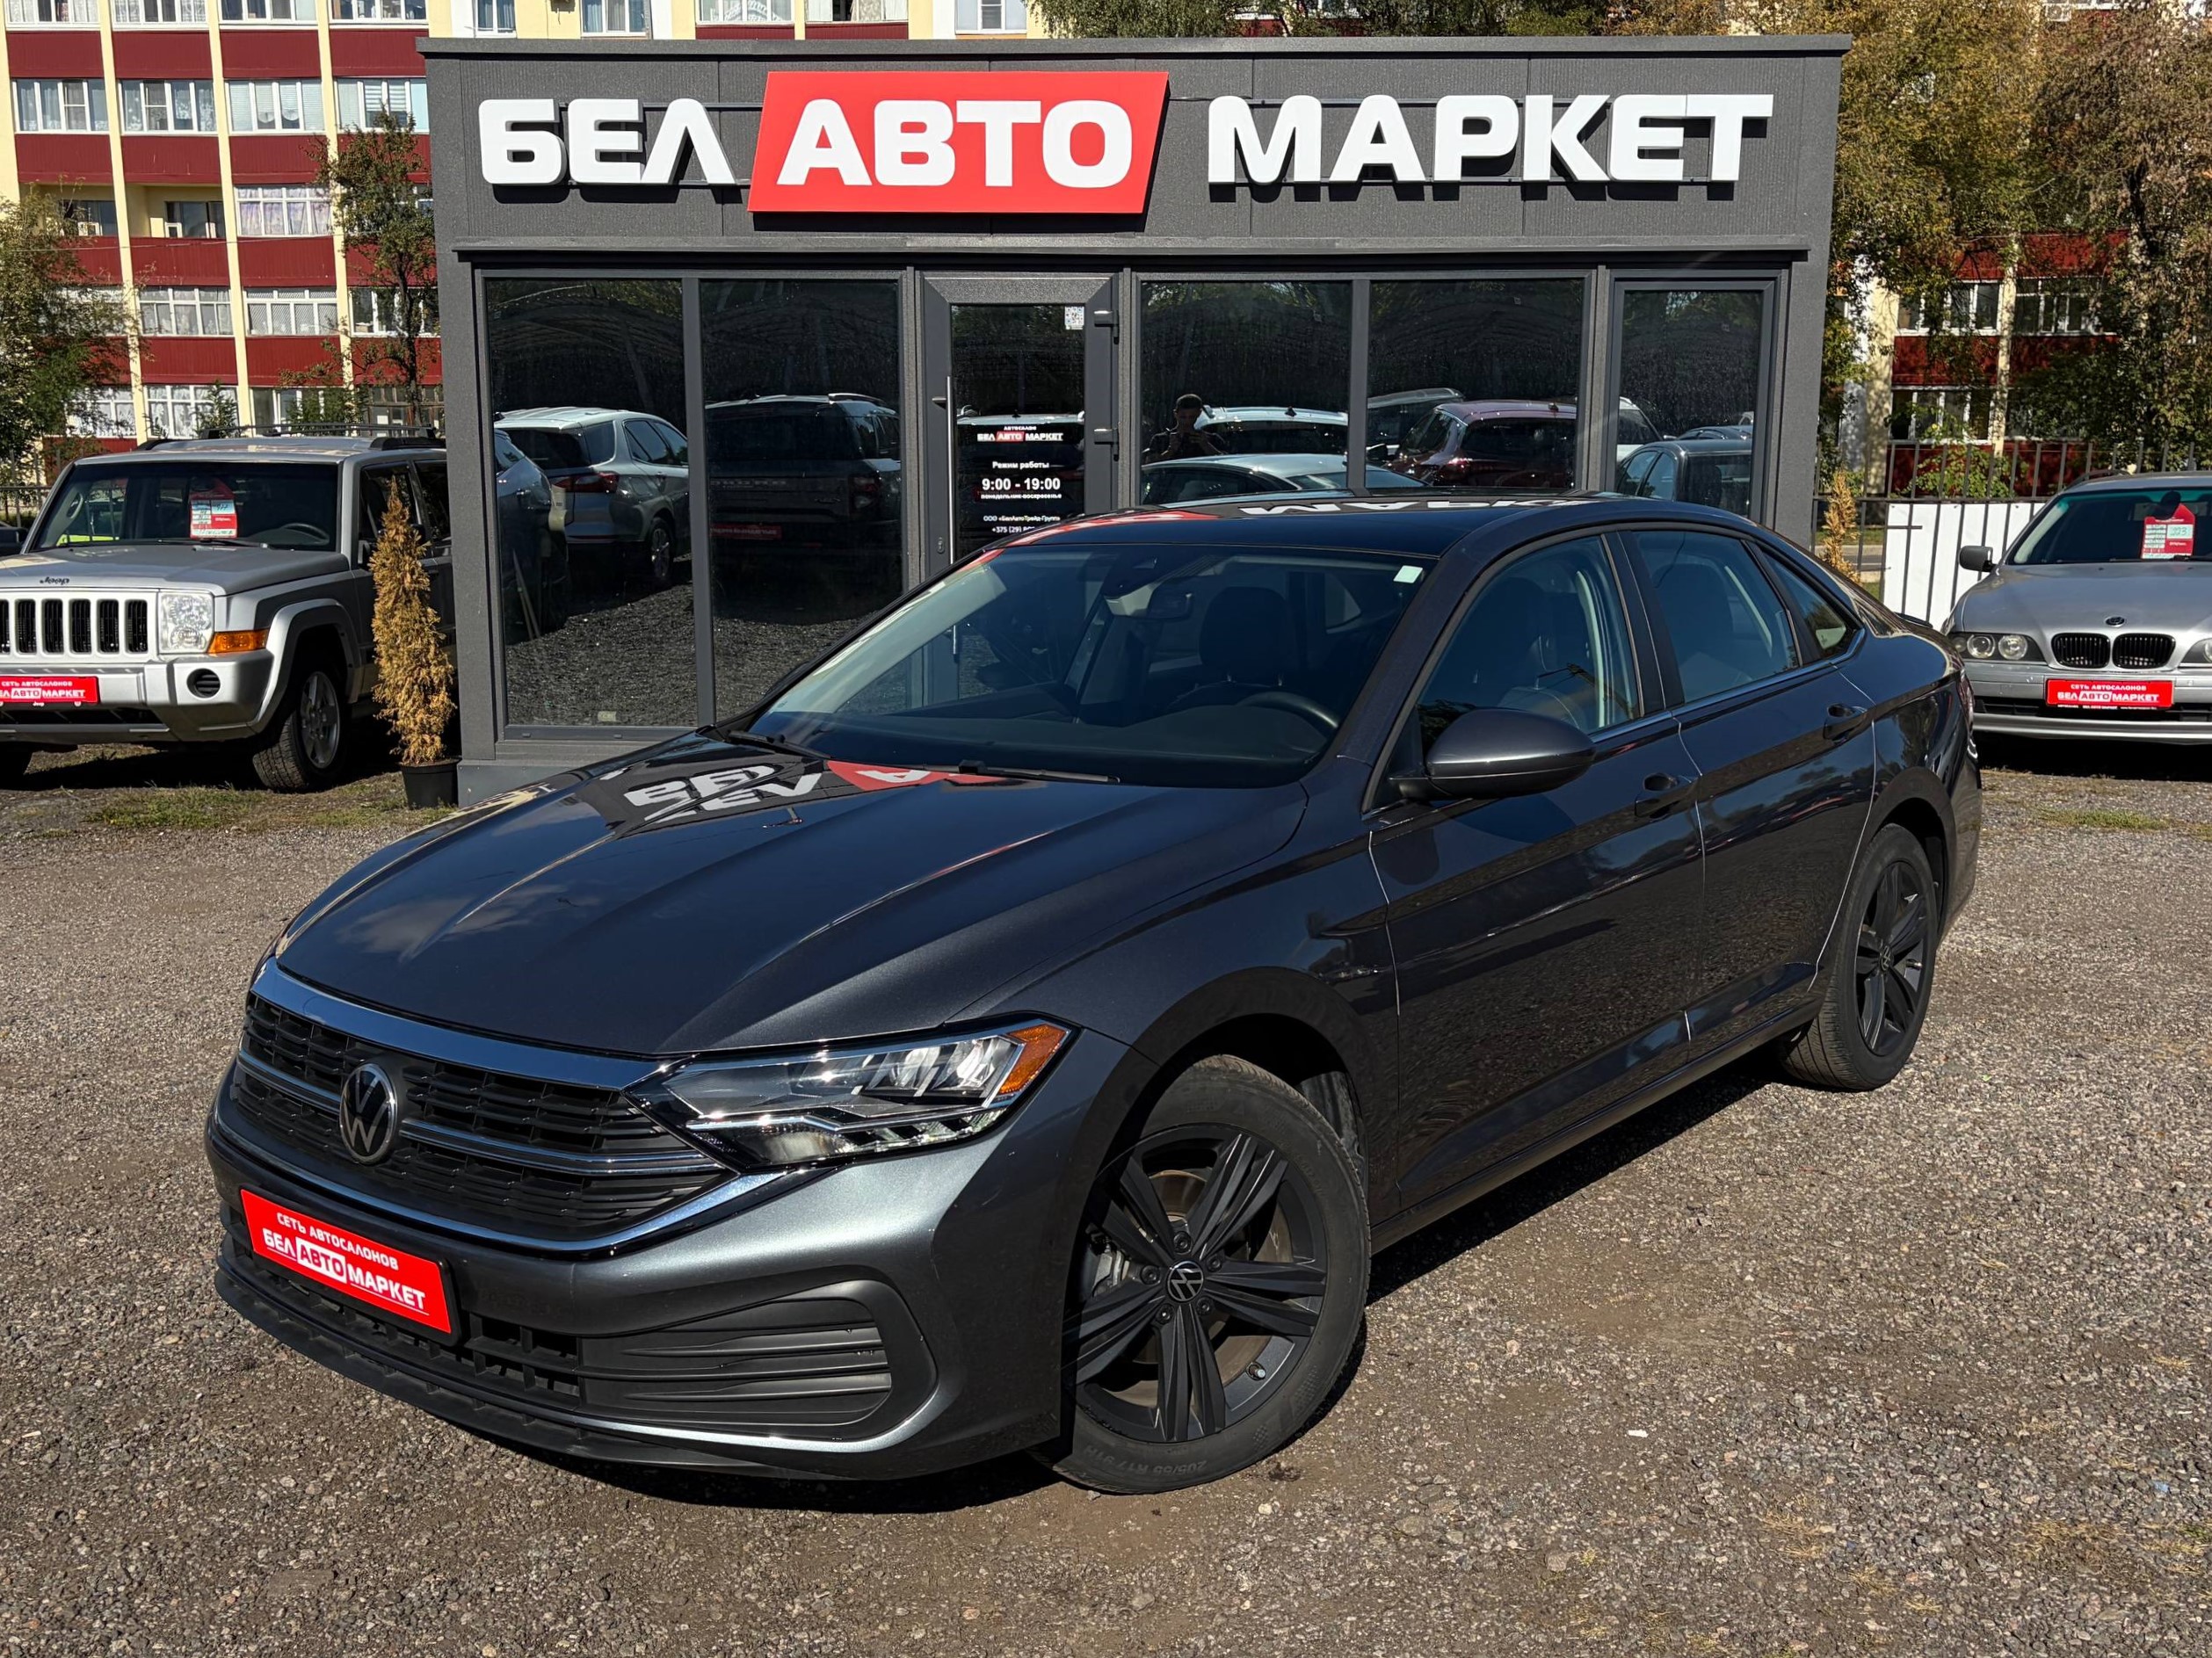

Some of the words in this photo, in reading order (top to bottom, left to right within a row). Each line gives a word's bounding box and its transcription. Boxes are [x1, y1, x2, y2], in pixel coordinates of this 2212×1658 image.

[478, 98, 736, 185] БЕЛ
[776, 98, 1134, 188] АВТО
[1208, 94, 1774, 185] МАРКЕТ
[976, 433, 996, 442] БЕЛ
[1025, 432, 1064, 442] МАРКЕТ
[1019, 460, 1049, 470] работы
[982, 478, 1012, 490] 9:00
[1024, 478, 1061, 490] 19:00
[2057, 691, 2079, 700] БЕЛ
[2112, 693, 2159, 702] МАРКЕТ
[276, 1212, 307, 1234] СЕТЬ
[309, 1226, 399, 1271] АВТОСАЛОНОВ
[263, 1227, 297, 1258] БЕЛ
[299, 1242, 345, 1278] АВТО
[347, 1263, 425, 1310] МАРКЕТ
